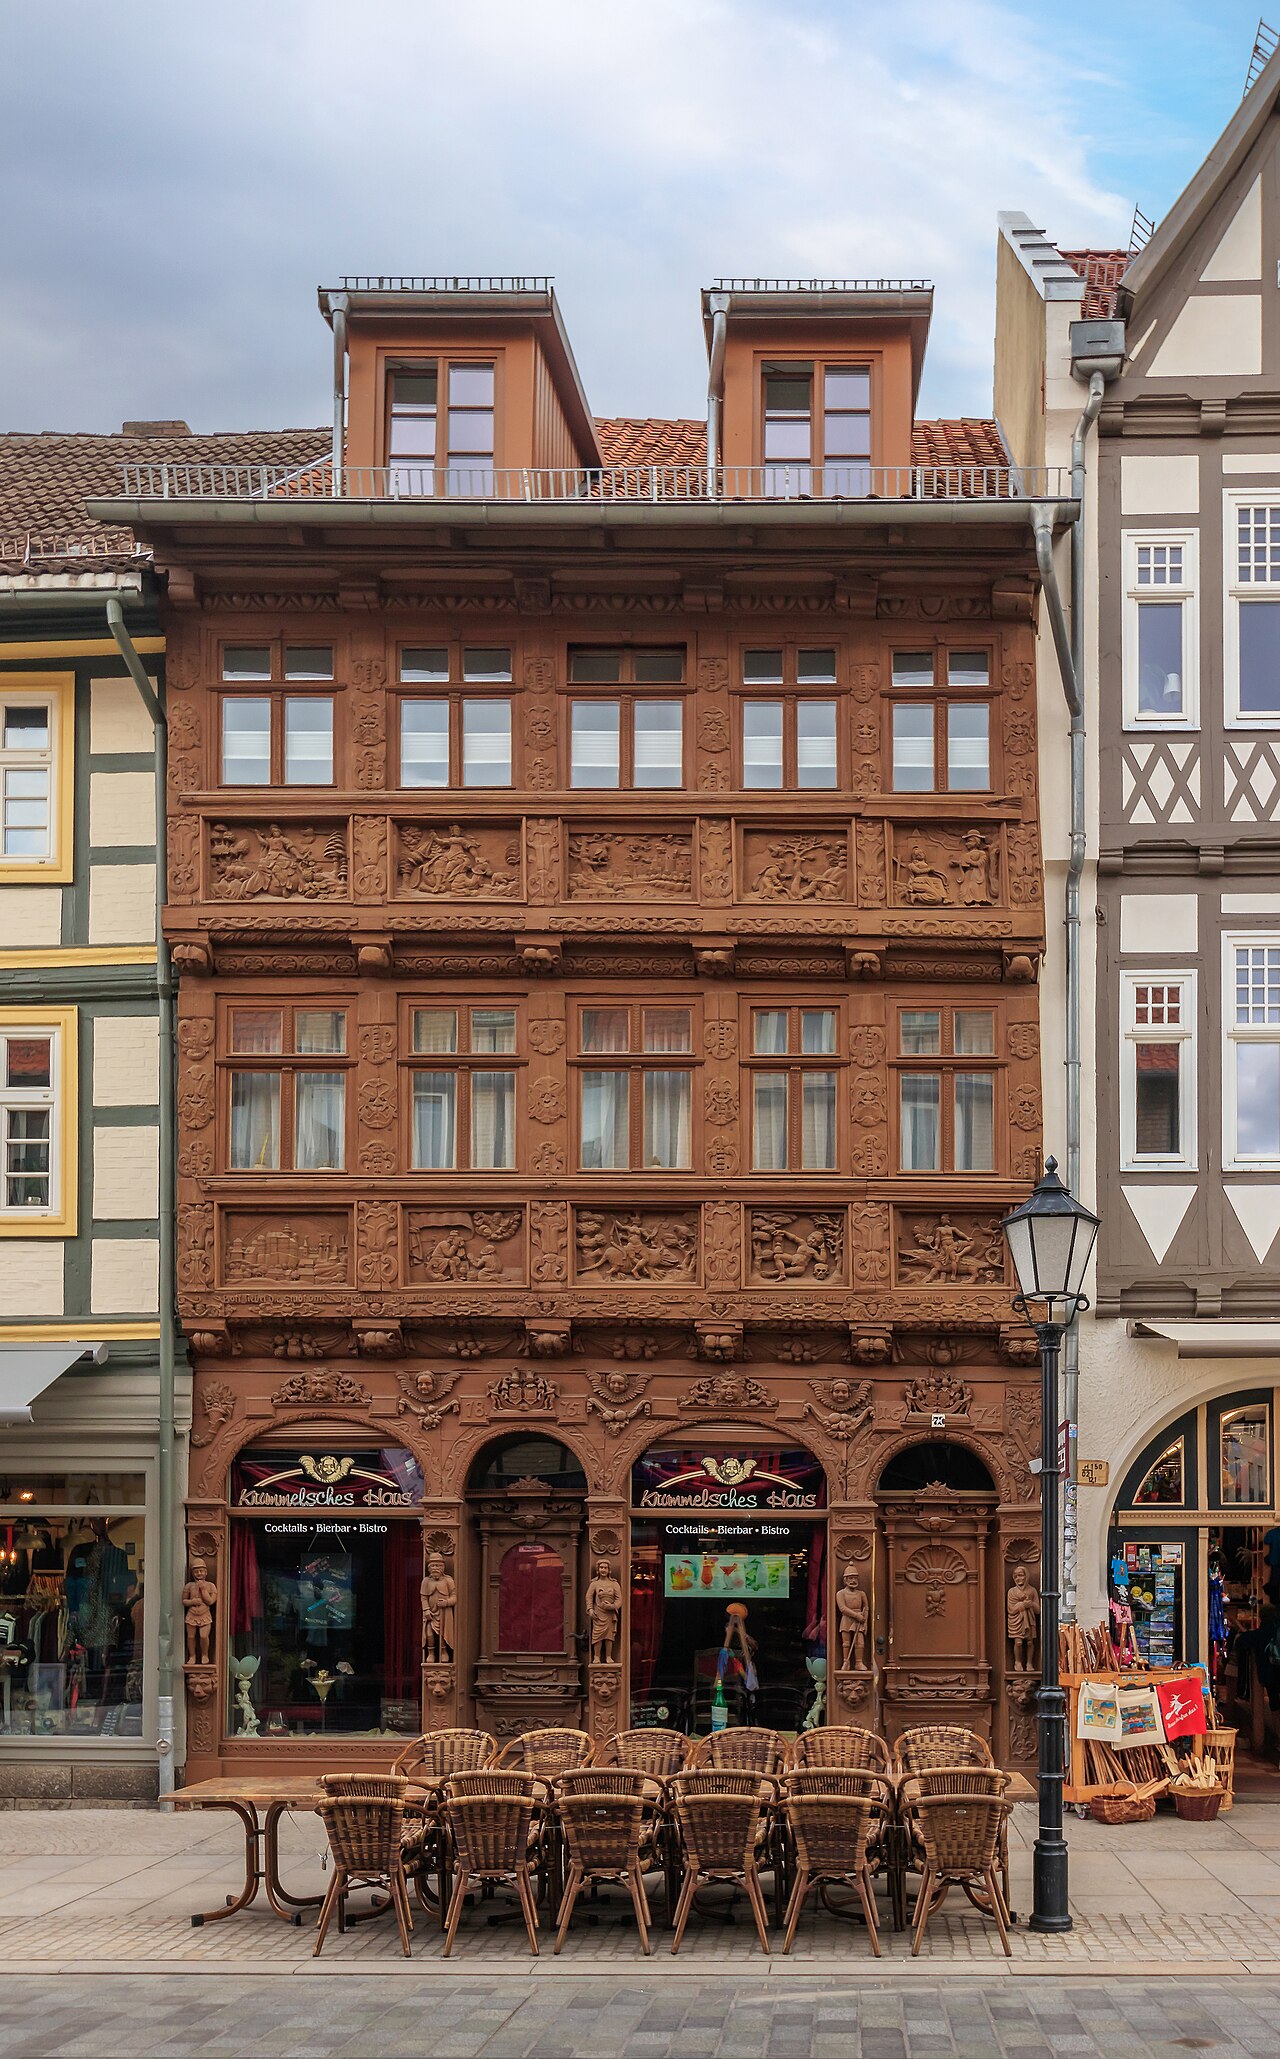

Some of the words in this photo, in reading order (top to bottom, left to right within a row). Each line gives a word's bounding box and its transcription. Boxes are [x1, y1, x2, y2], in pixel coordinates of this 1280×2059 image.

[362, 1488, 413, 1506] Haus
[766, 1490, 817, 1508] Haus
[264, 1523, 308, 1533] Cocktails
[315, 1523, 351, 1533] Bierbar
[359, 1523, 388, 1533] Bistro
[665, 1524, 709, 1534] Cocktails
[717, 1525, 753, 1535] Bierbar
[761, 1525, 790, 1535] Bistro
